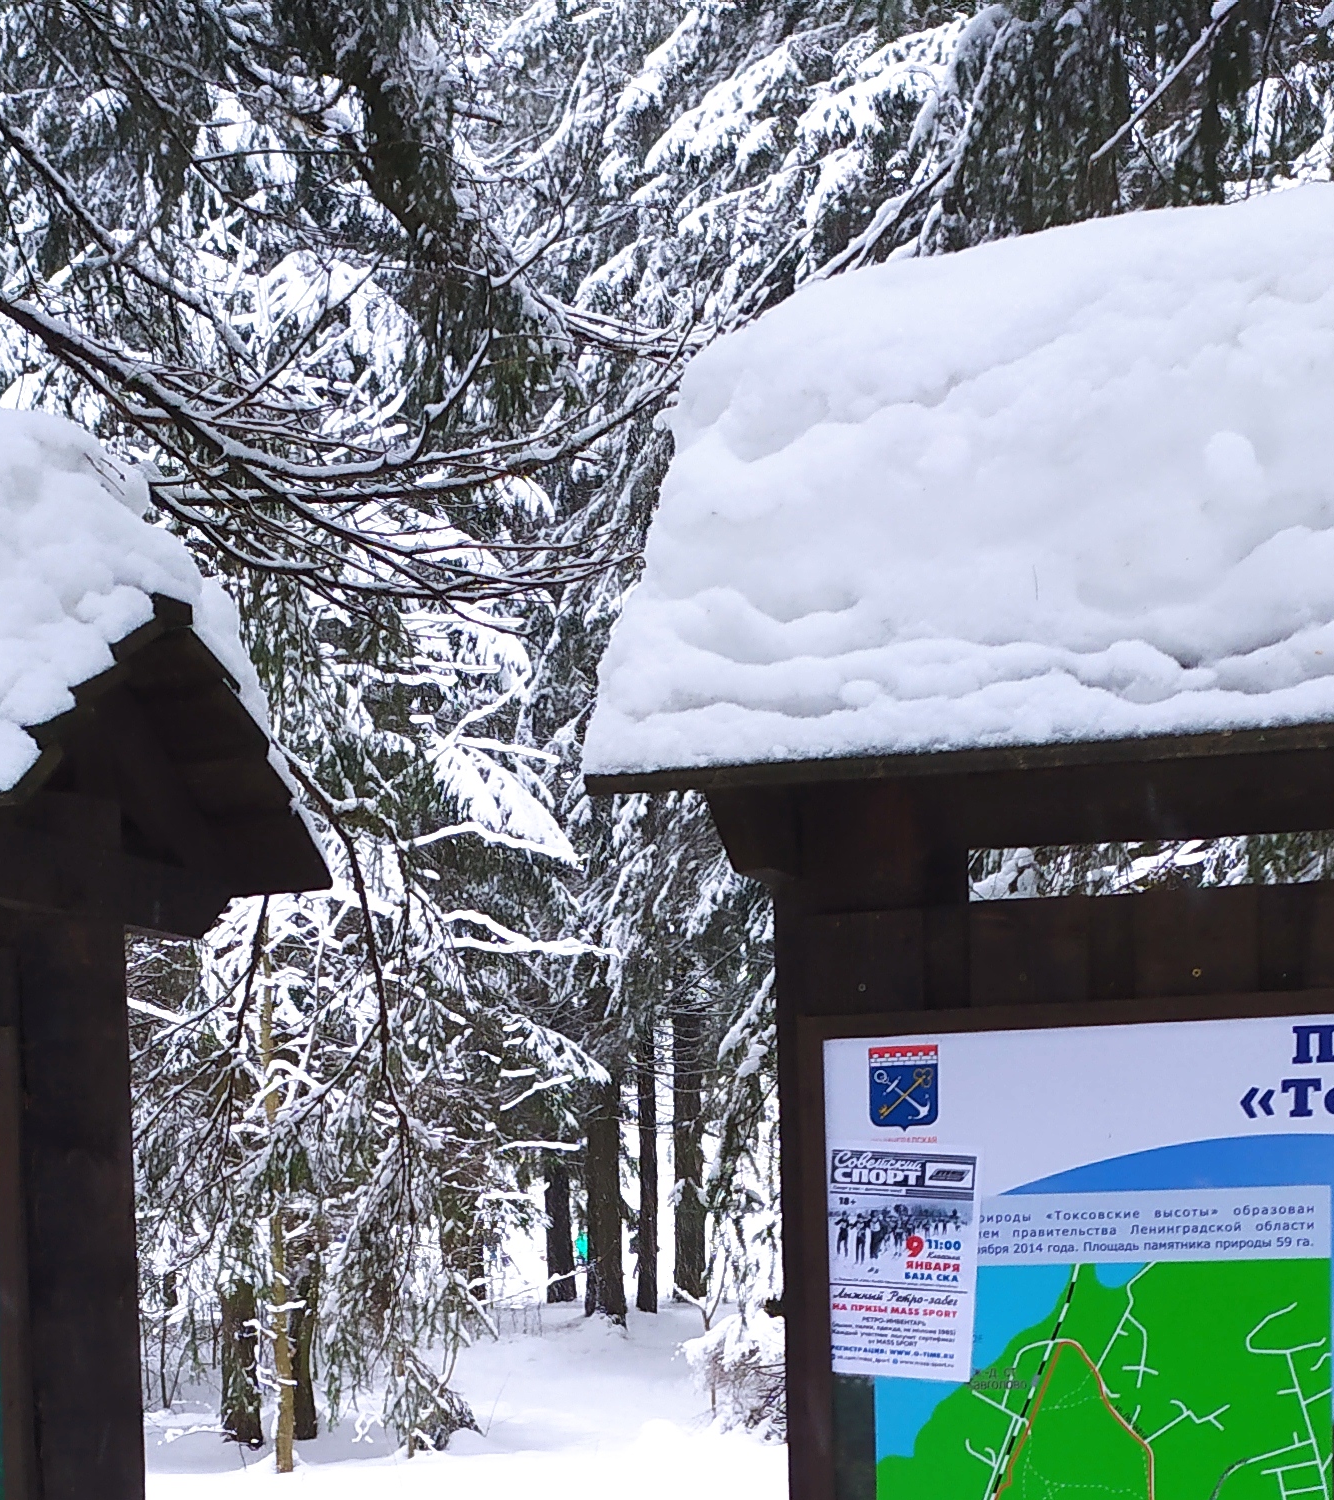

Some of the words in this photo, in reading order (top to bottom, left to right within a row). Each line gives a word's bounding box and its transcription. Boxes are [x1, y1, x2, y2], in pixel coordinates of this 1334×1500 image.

[834, 1168, 922, 1186] СПОРТ
[839, 1197, 857, 1206] 18+
[1045, 1207, 1140, 1221] «Токсовские
[1153, 1207, 1218, 1218] высоты»
[1232, 1203, 1314, 1216] образован
[1012, 1226, 1116, 1238] правительства
[1129, 1221, 1241, 1235] Ленинградской
[1254, 1219, 1314, 1231] области
[906, 1235, 924, 1258] 9
[925, 1239, 962, 1251] 11:00
[1012, 1242, 1043, 1254] 2014
[1047, 1243, 1079, 1254] года.
[1082, 1240, 1139, 1253] Площадь
[1143, 1240, 1211, 1250] памятника
[1214, 1239, 1272, 1250] природы
[1275, 1236, 1292, 1247] 59
[1296, 1237, 1314, 1247] га.
[906, 1260, 961, 1272] ЯНВАРЯ
[904, 1272, 933, 1281] БАЗА
[936, 1273, 959, 1283] СКА
[833, 1287, 885, 1302] Лыжный
[833, 1302, 849, 1312] НА
[851, 1303, 888, 1313] ПРИЗЫ
[890, 1306, 920, 1316] MASS
[922, 1307, 958, 1318] SPORT
